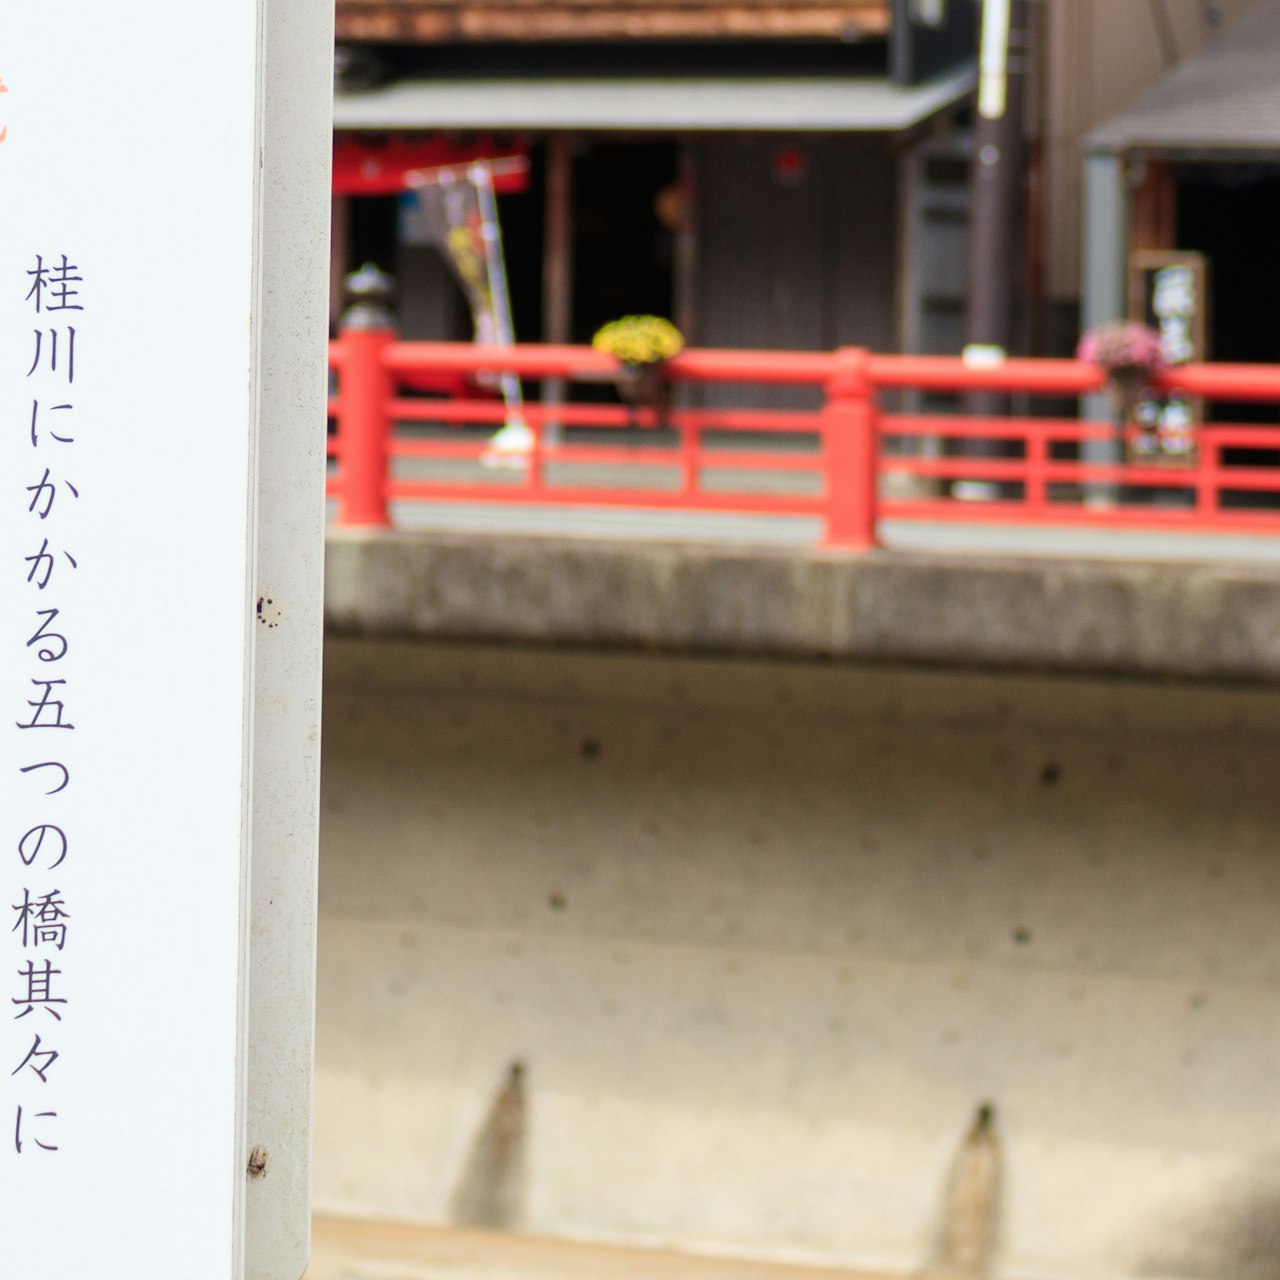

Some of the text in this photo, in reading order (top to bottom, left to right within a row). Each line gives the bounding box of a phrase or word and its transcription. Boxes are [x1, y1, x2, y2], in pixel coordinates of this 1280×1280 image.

[10, 253, 85, 1155] 桂川にかかる五つの橋其々に
